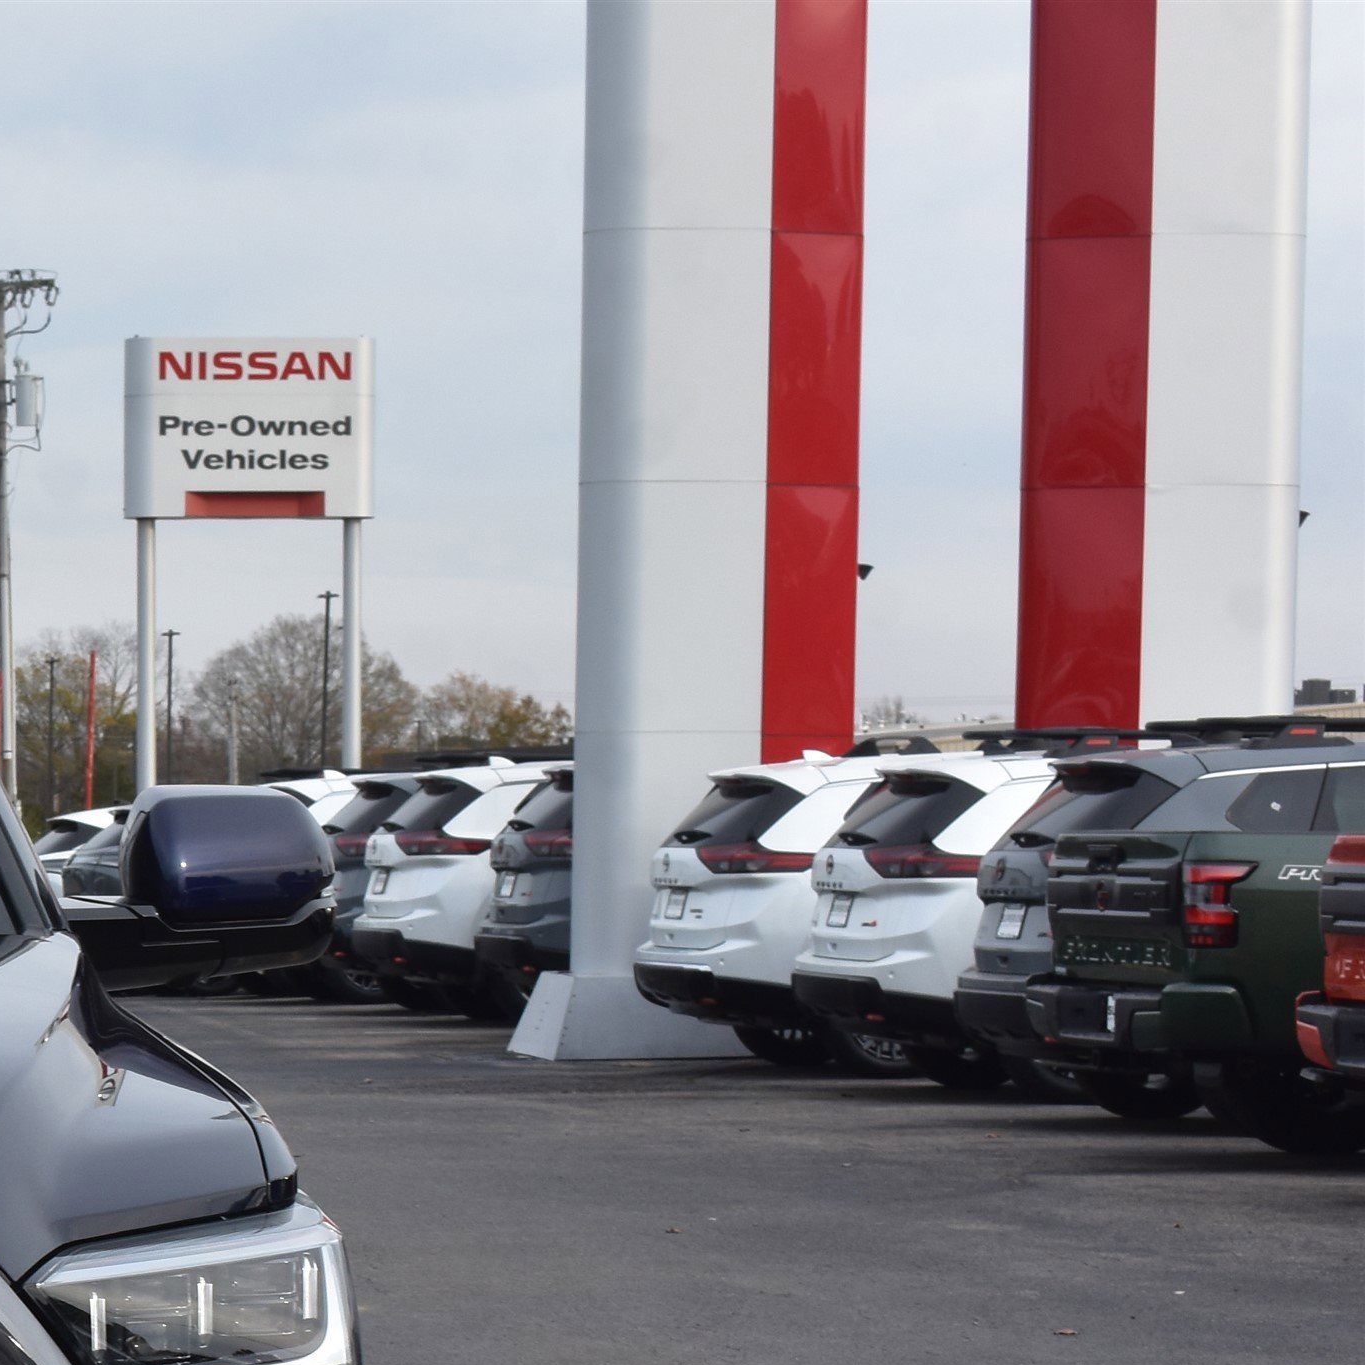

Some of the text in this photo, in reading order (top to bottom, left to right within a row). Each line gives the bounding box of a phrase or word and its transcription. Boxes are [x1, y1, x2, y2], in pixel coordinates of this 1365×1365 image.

[158, 351, 352, 381] NISSAN
[158, 415, 352, 437] Pre-Owned
[181, 449, 329, 471] Vehicles
